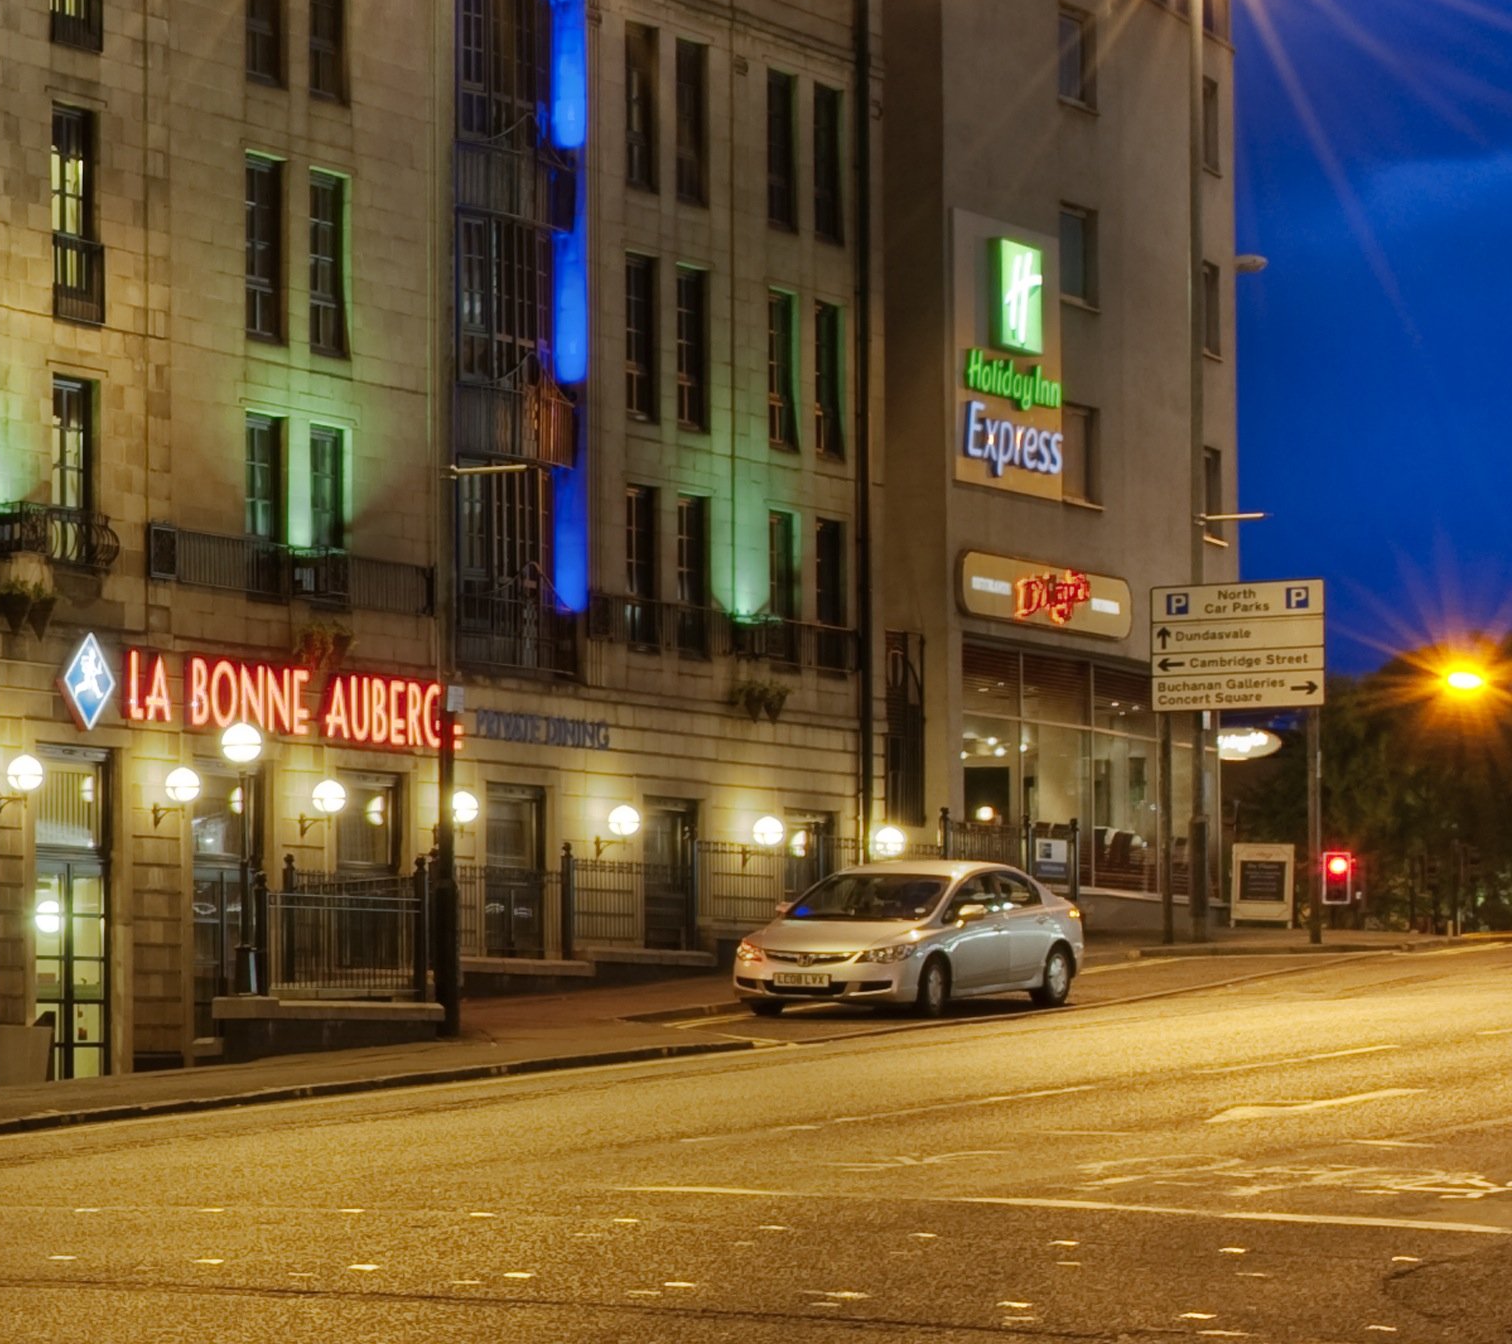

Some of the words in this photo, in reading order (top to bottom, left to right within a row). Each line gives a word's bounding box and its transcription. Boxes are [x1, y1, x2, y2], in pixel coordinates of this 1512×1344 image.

[967, 348, 1033, 411] Holiday
[1034, 365, 1061, 408] Inn
[967, 400, 1063, 476] Express
[1217, 588, 1256, 600] North
[1204, 603, 1227, 614] Car
[1232, 601, 1270, 613] Parks
[1175, 628, 1252, 642] Dundasvale
[1189, 655, 1262, 670] Cambridge
[1266, 653, 1309, 665] Street
[1157, 680, 1222, 693] Buchanan
[1226, 678, 1285, 690] Galleries
[128, 649, 172, 721] LA
[190, 657, 309, 734] BONNE
[325, 676, 464, 750] AUBERG
[1158, 694, 1211, 705] Concert
[1215, 692, 1263, 705] Square
[476, 707, 541, 744] PRIVATE
[547, 715, 610, 750] DINING
